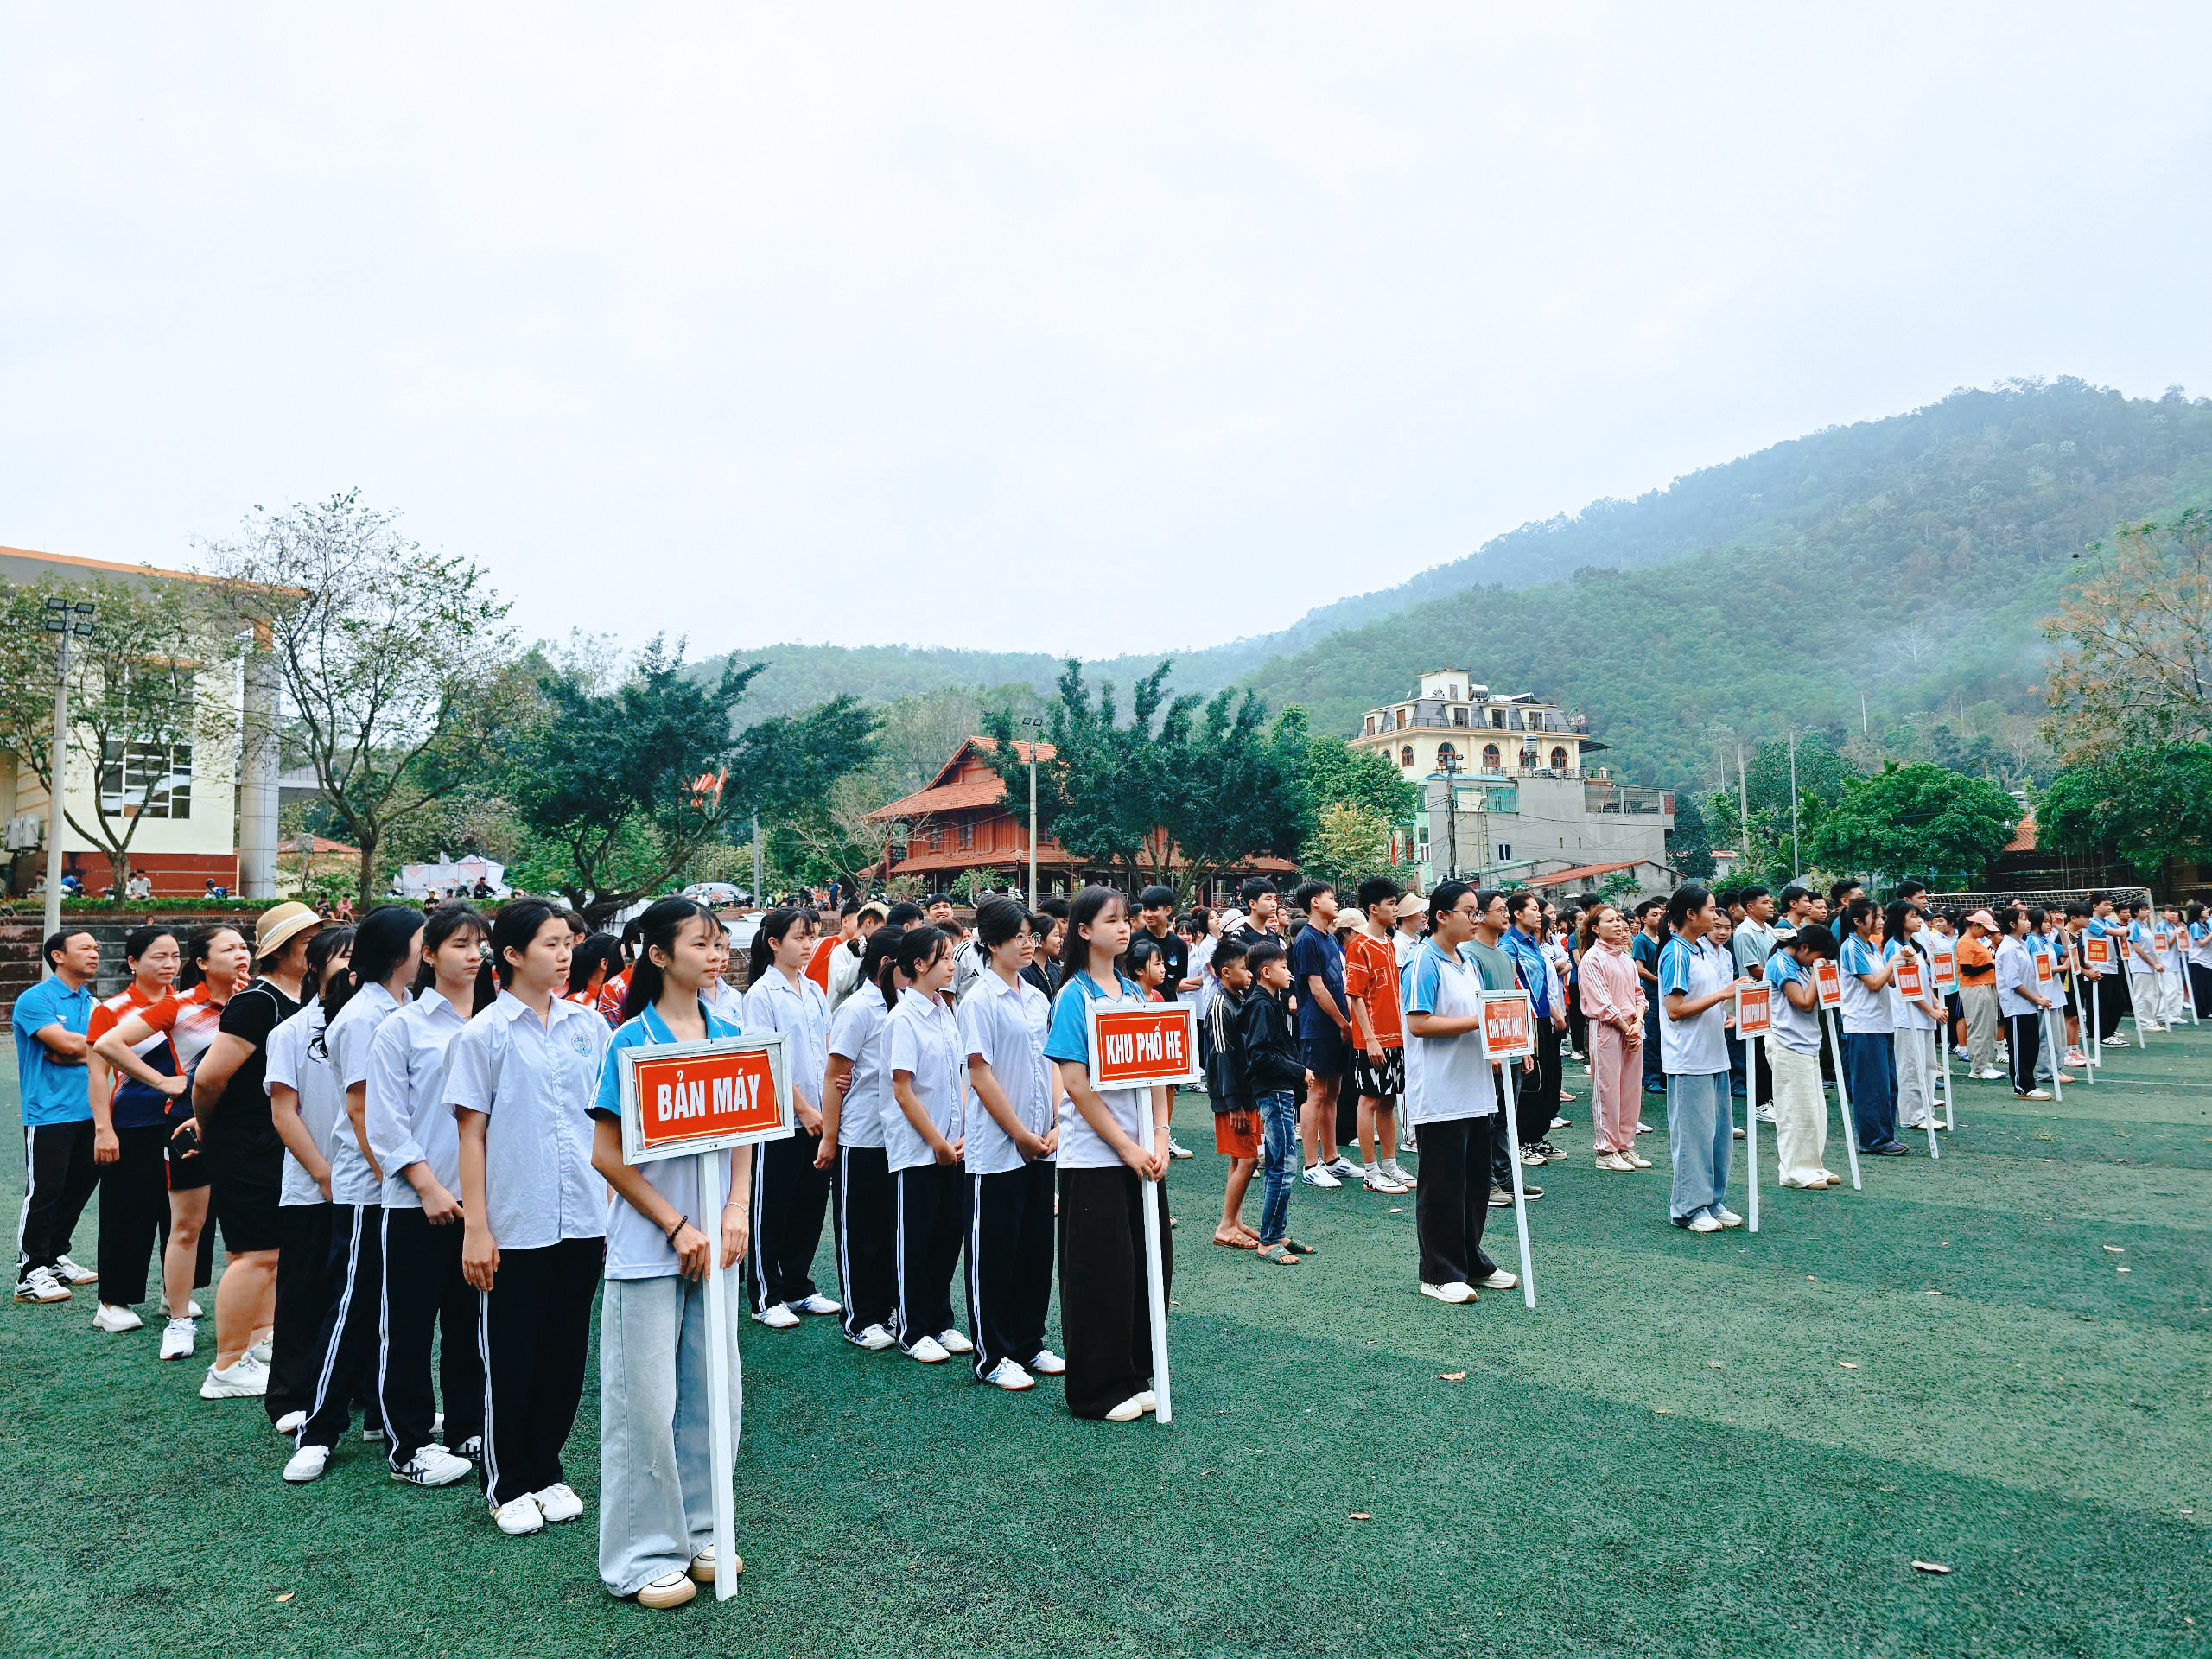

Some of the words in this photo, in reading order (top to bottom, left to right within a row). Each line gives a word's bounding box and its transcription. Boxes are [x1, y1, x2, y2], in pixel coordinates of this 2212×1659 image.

[1106, 1033, 1134, 1065] KHU
[1136, 1021, 1162, 1062] PHỐ
[1166, 1030, 1183, 1065] HẸ
[658, 1070, 706, 1122] BẢN
[712, 1068, 760, 1114] MÁY
